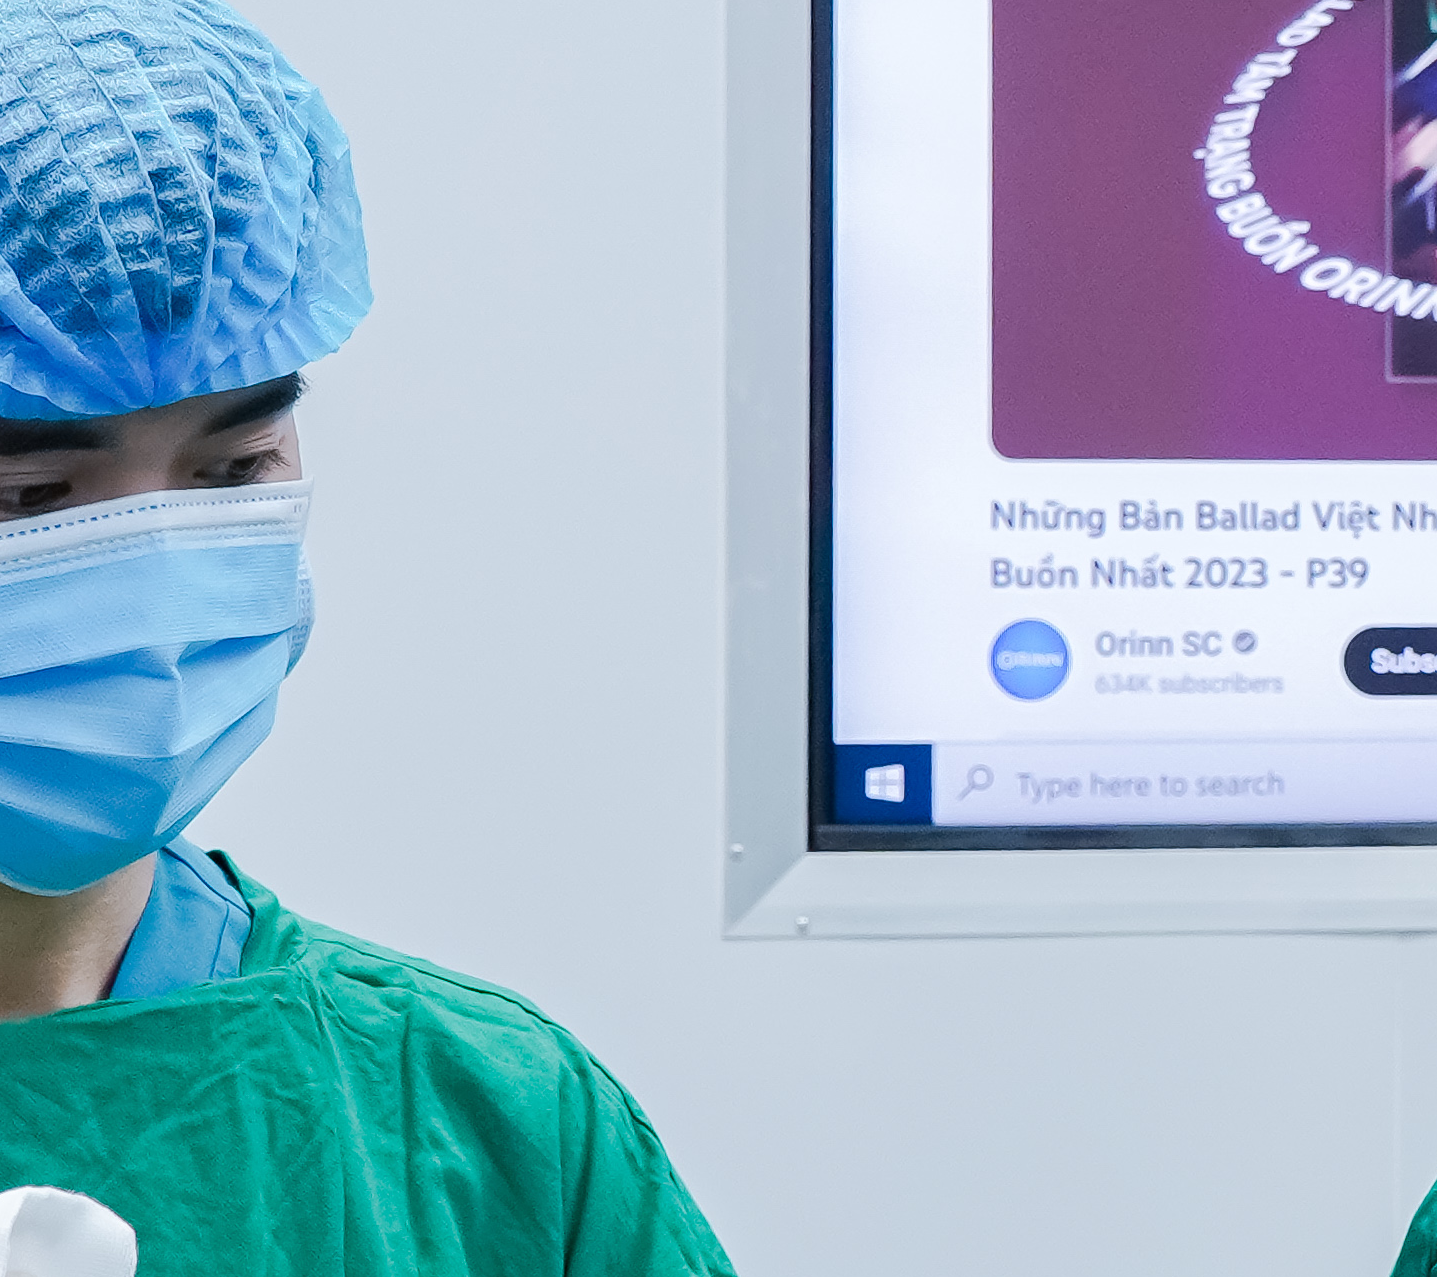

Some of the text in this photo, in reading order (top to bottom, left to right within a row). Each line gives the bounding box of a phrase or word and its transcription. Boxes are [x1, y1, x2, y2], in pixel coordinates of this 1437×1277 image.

[991, 499, 1106, 539] Những
[1119, 499, 1184, 531] Bản
[1195, 500, 1301, 531] Ballad
[1312, 500, 1381, 540] Việt
[1091, 553, 1174, 588] Nhất
[1184, 557, 1268, 588] 2023
[1307, 557, 1370, 588] P39
[1095, 630, 1222, 657] Orinn SC
[1158, 673, 1284, 694] subscribers
[1017, 770, 1285, 804] Type here to search
